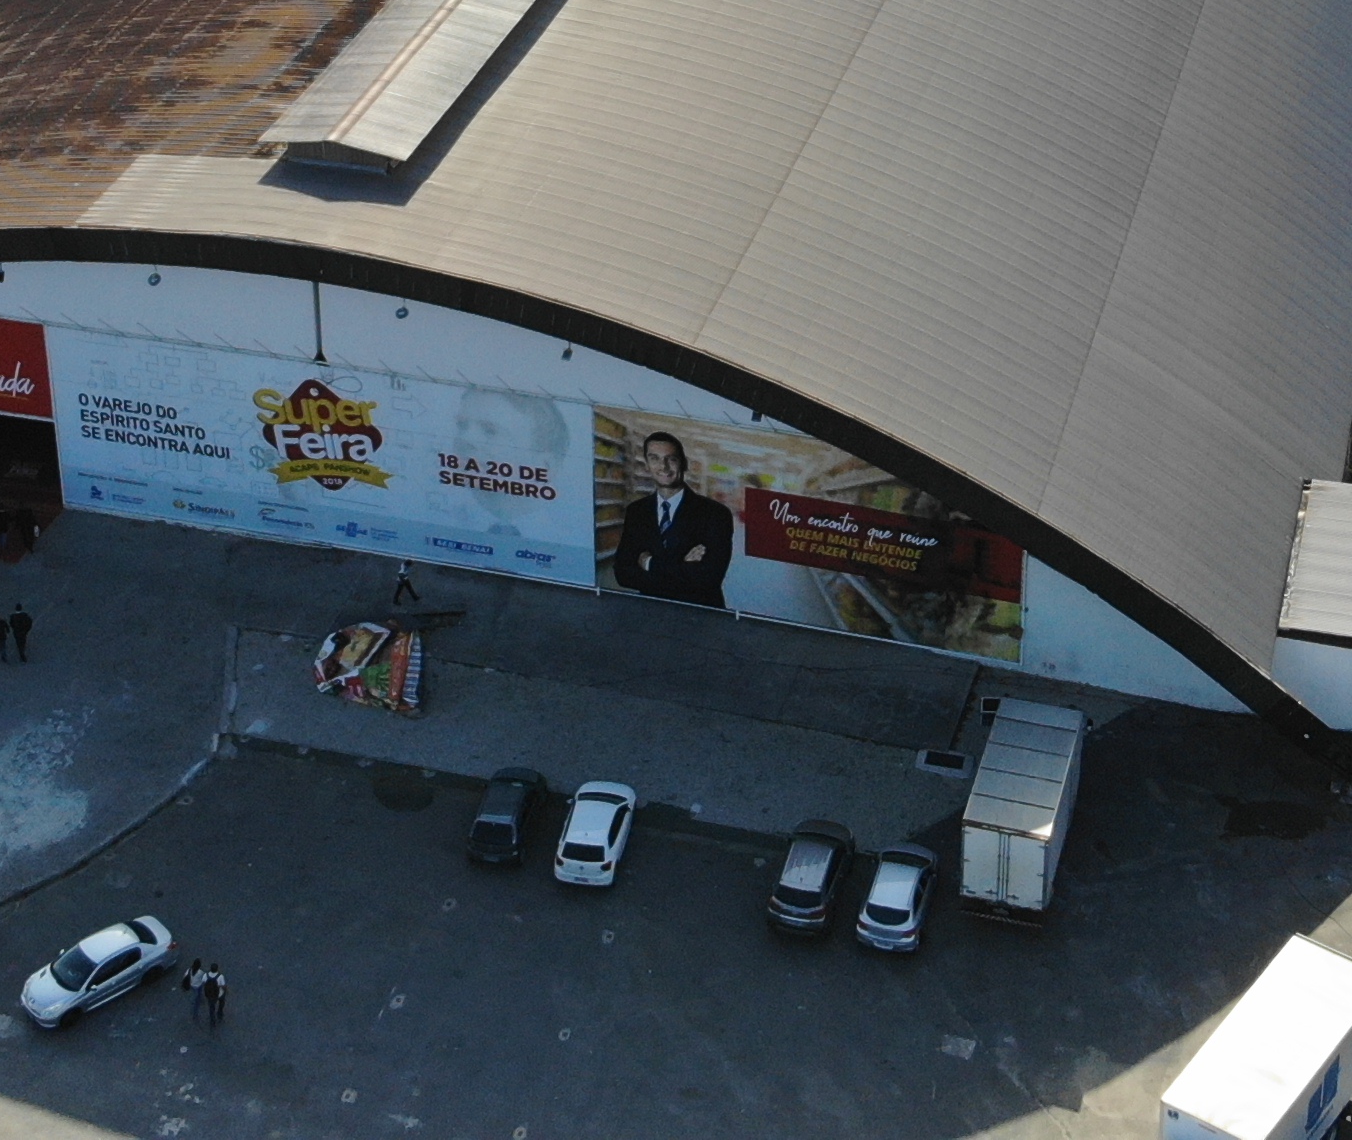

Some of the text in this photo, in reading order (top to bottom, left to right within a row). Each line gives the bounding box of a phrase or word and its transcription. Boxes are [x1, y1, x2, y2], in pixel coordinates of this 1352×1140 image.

[78, 393, 177, 420] O VAREJO DO
[252, 388, 379, 433] Super
[80, 409, 206, 440] ESPÍRITO SANTO
[81, 425, 231, 460] SE ENCONTRA AQUI
[273, 424, 375, 462] Feira
[438, 452, 549, 483] 18 A 20 DE
[439, 470, 556, 500] SETEMBRO
[769, 498, 801, 525] Um
[807, 512, 859, 533] encontro
[867, 527, 894, 547] que
[786, 527, 924, 560] QUEM MAIS ENTENDE
[789, 540, 918, 572] DE FAZER NEGÓCIOS
